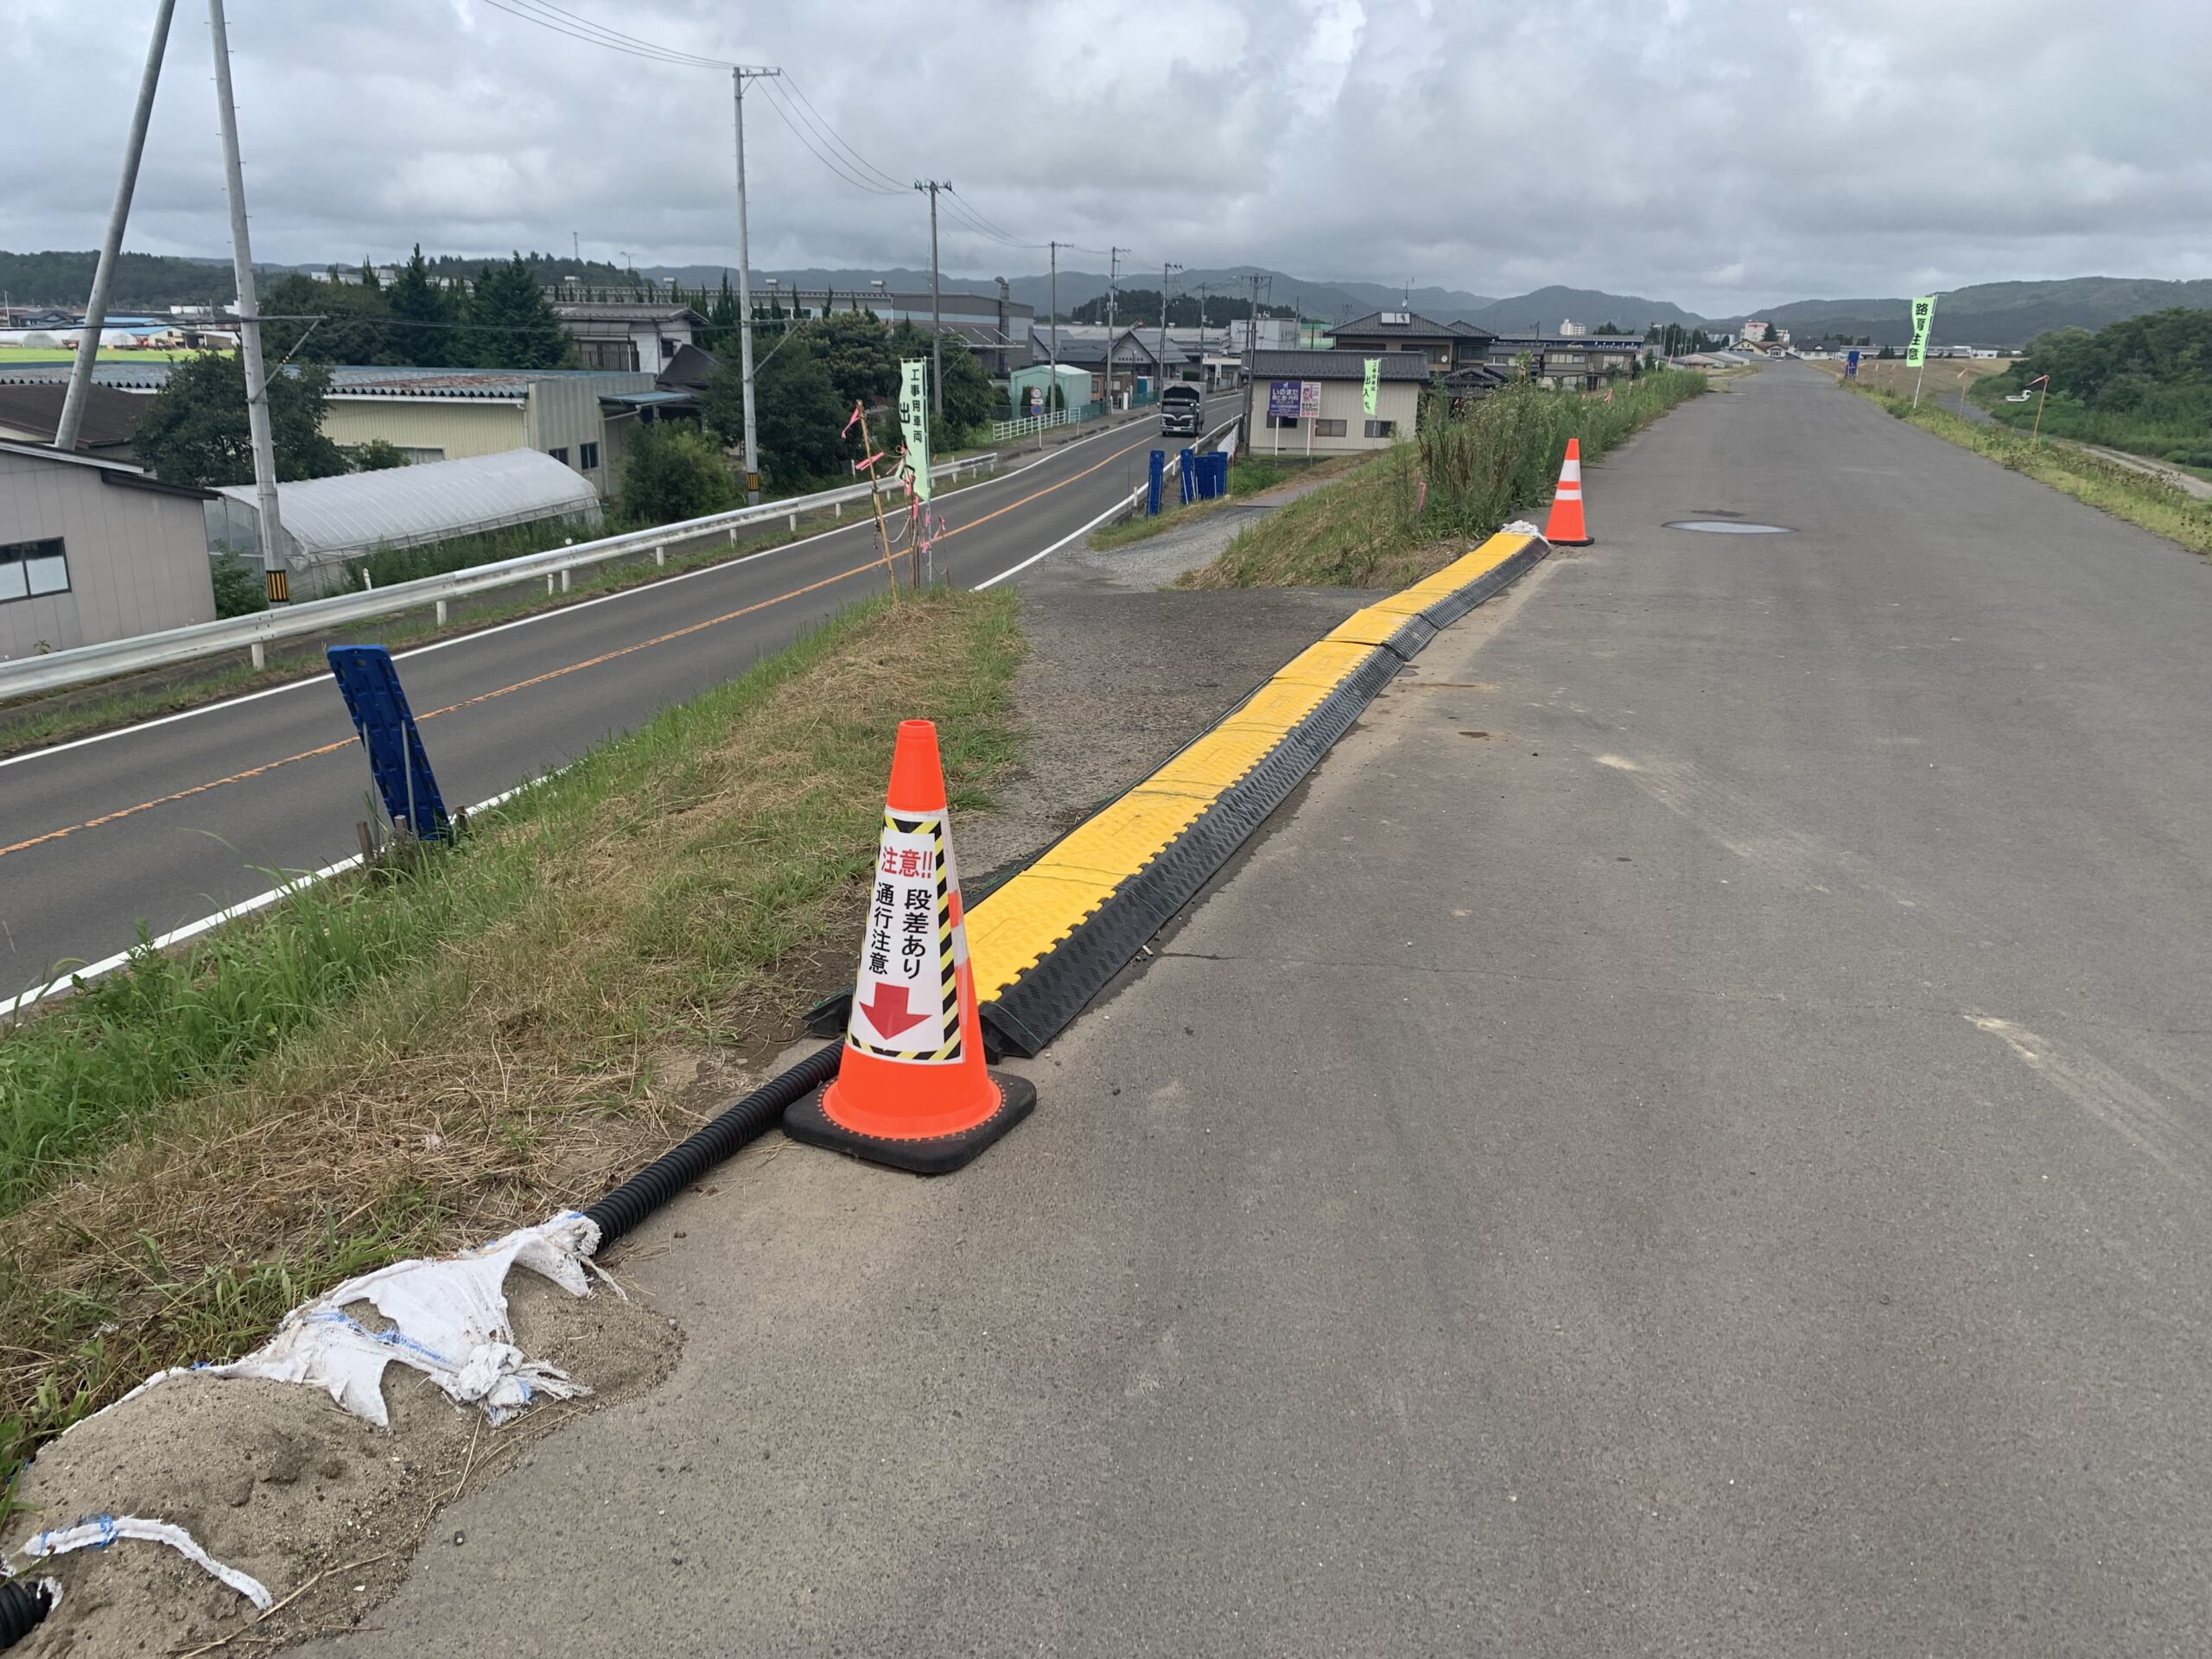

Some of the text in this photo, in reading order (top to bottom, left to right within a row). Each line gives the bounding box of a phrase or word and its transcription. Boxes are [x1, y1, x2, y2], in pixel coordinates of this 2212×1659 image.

[910, 369, 923, 443] 工事用車両
[869, 882, 895, 975] 通行注意
[901, 888, 932, 980] 段差あり
